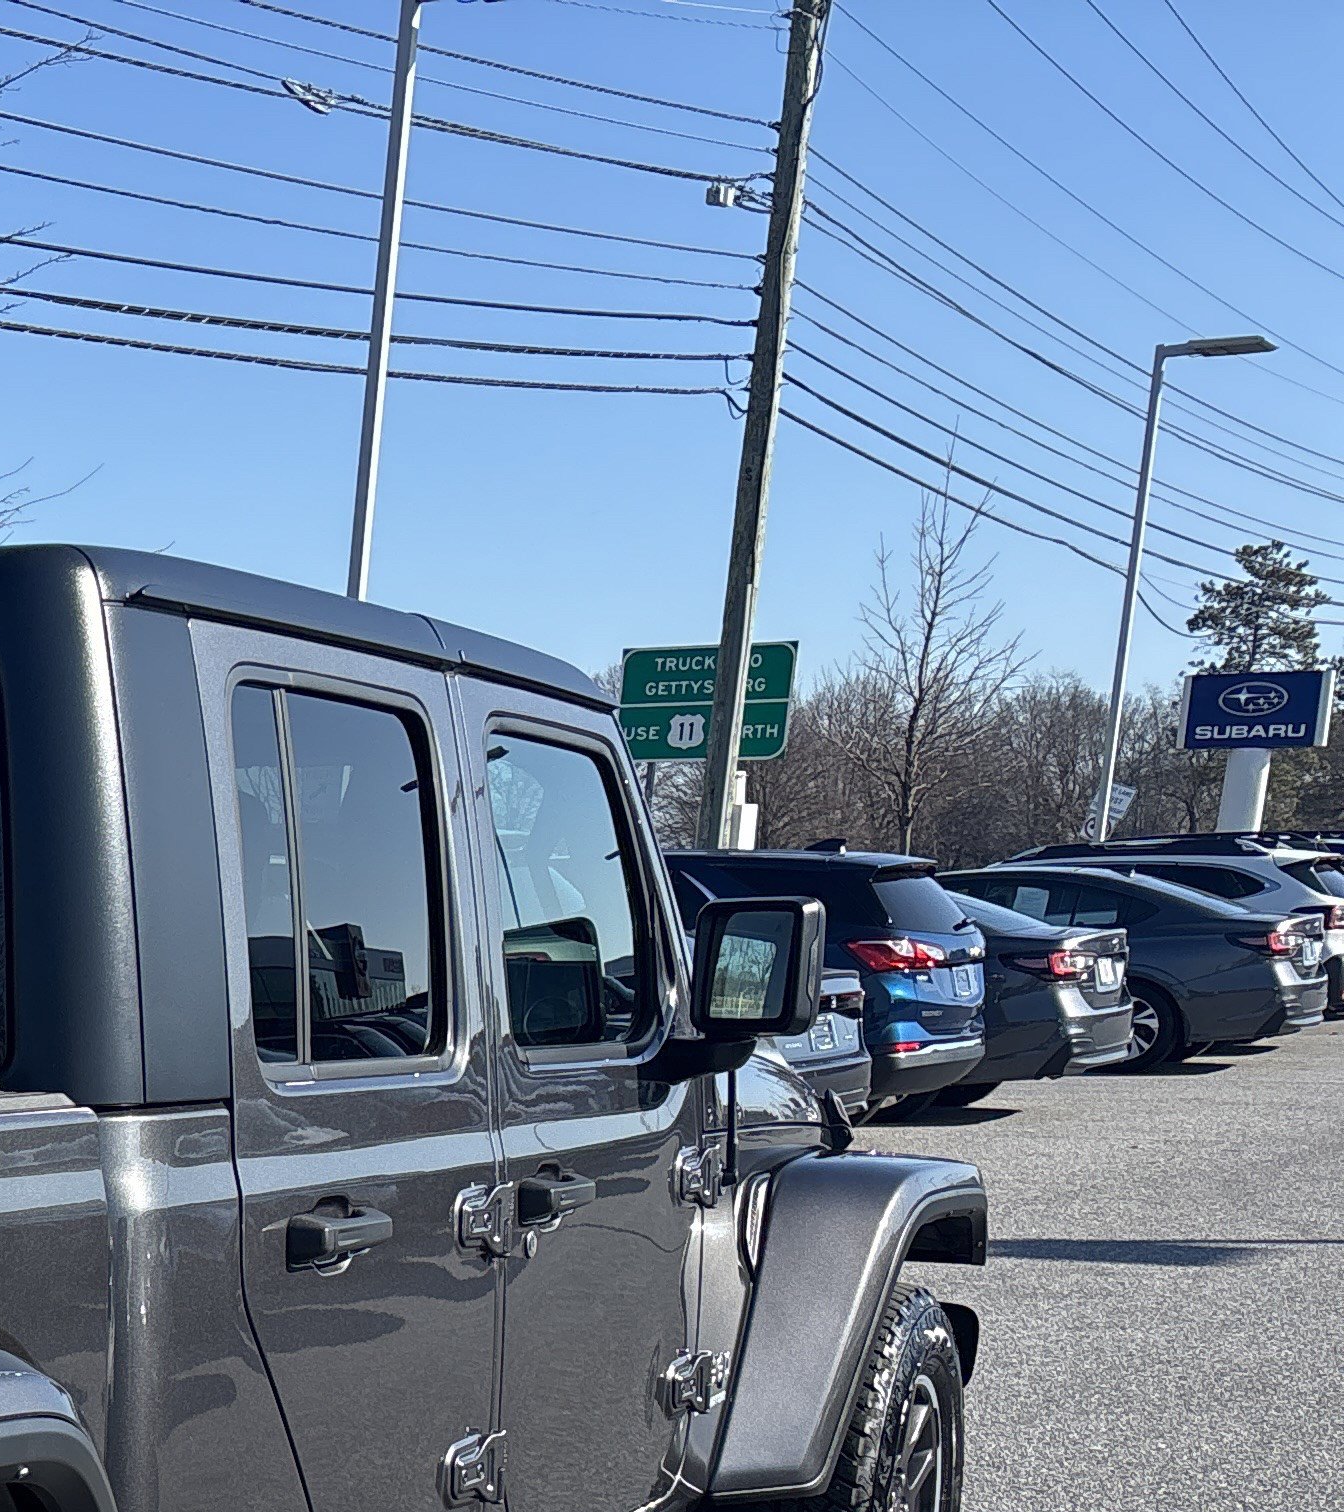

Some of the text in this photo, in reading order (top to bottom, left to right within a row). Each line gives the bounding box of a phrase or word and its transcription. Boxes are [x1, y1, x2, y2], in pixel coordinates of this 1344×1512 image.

[655, 653, 762, 671] TRUCK O
[645, 677, 766, 696] GETTYSRG
[624, 721, 779, 742] USE 11 RTH
[1194, 724, 1307, 740] SUBARU
